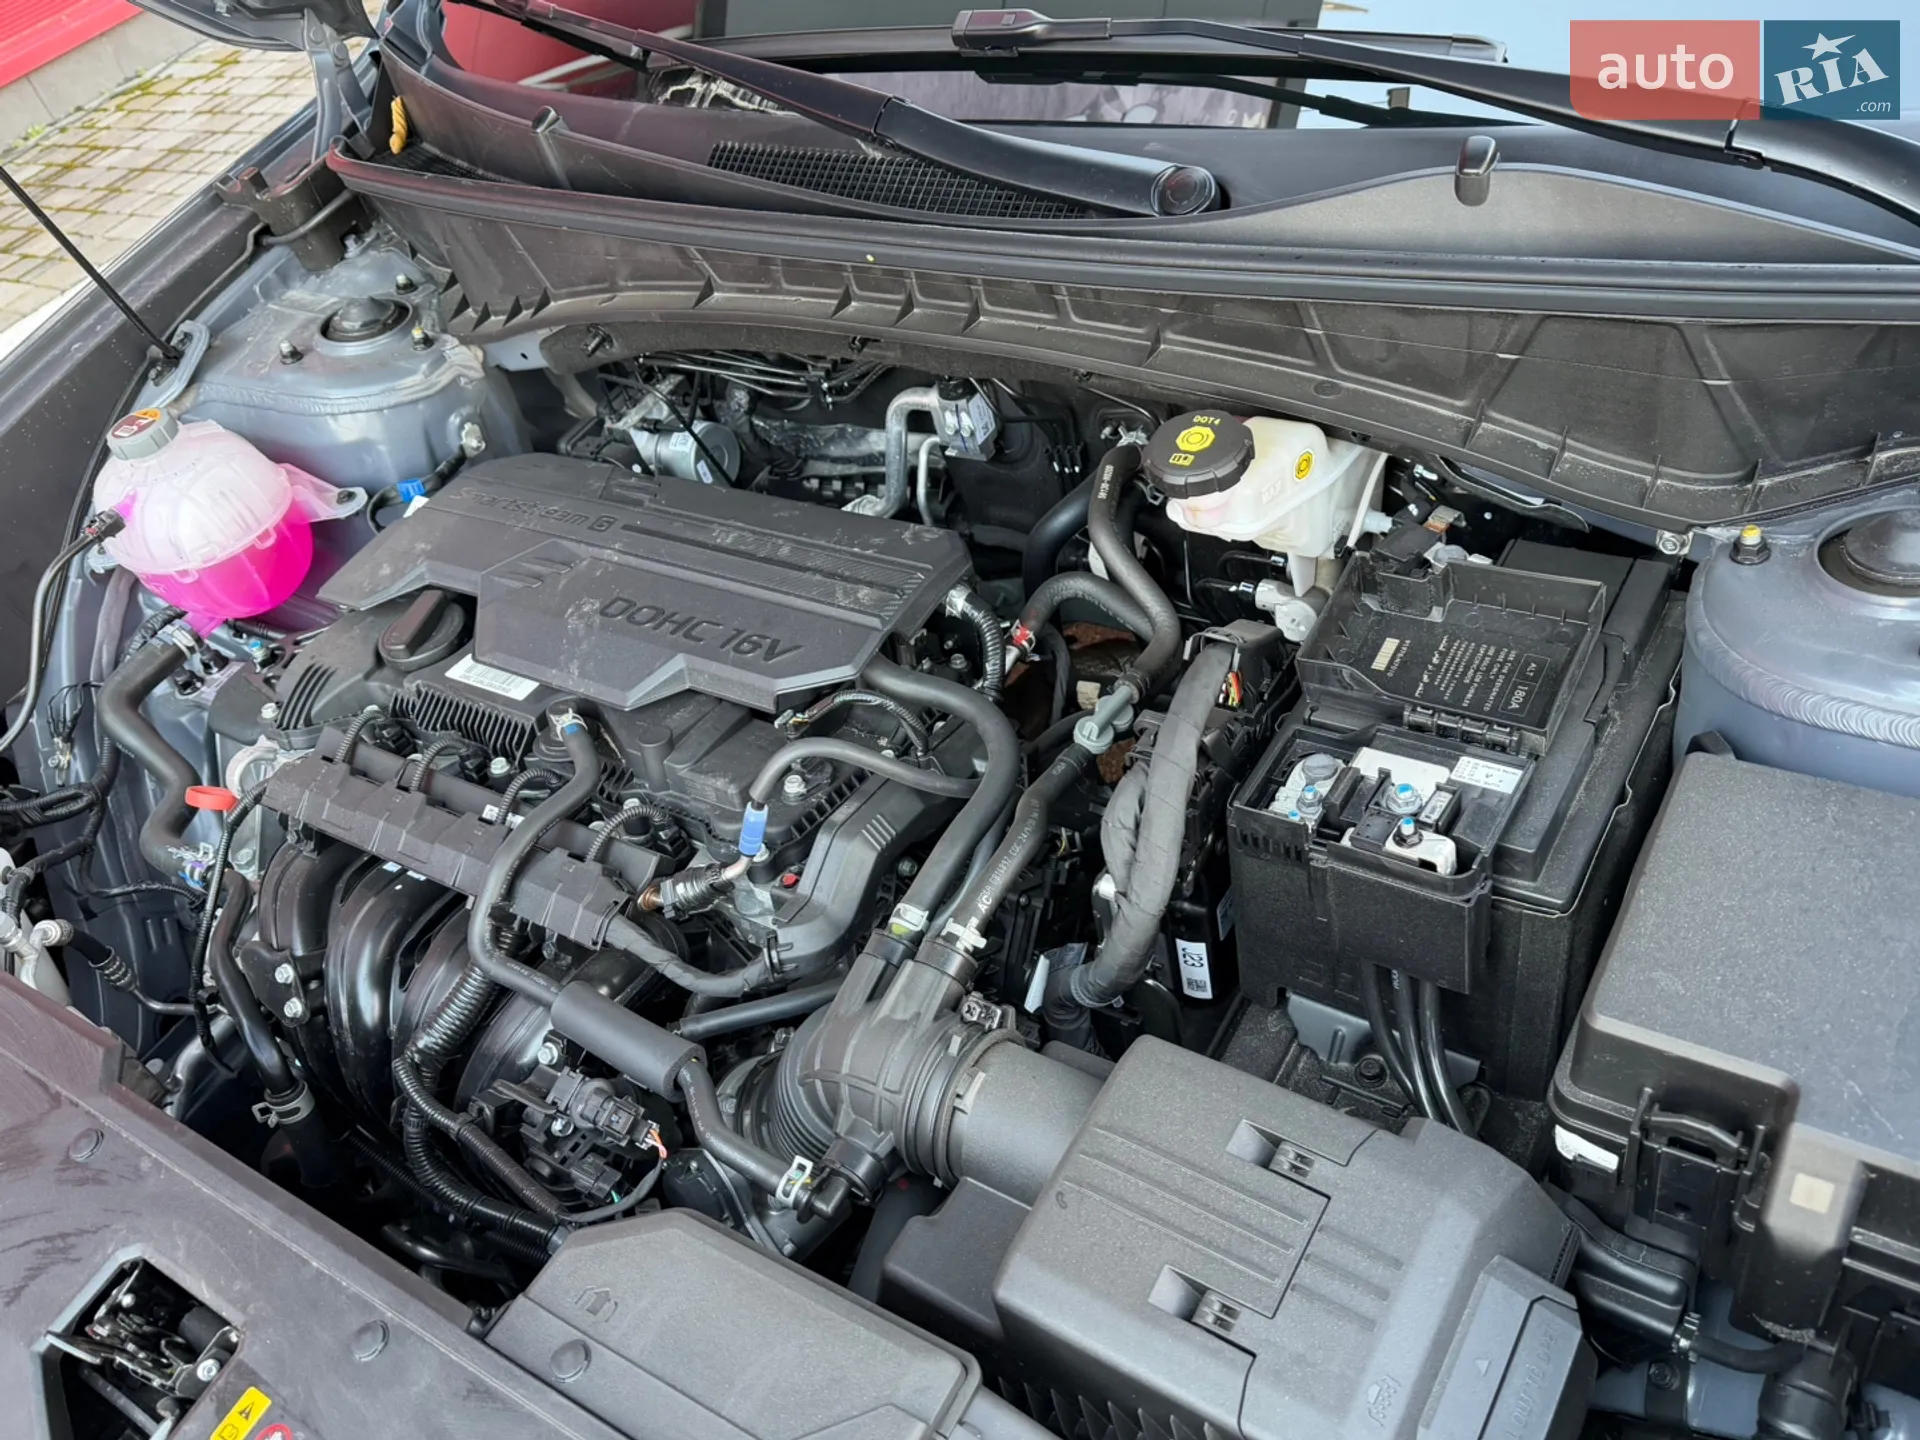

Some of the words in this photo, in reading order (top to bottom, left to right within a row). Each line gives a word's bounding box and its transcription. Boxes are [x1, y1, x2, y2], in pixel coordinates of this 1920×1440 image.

[1192, 415, 1221, 426] DOT4
[599, 597, 724, 644] DOHC
[719, 628, 805, 663] 16V
[1523, 662, 1538, 676] ALT
[1505, 684, 1530, 710] 180A
[1181, 947, 1204, 968] J23
